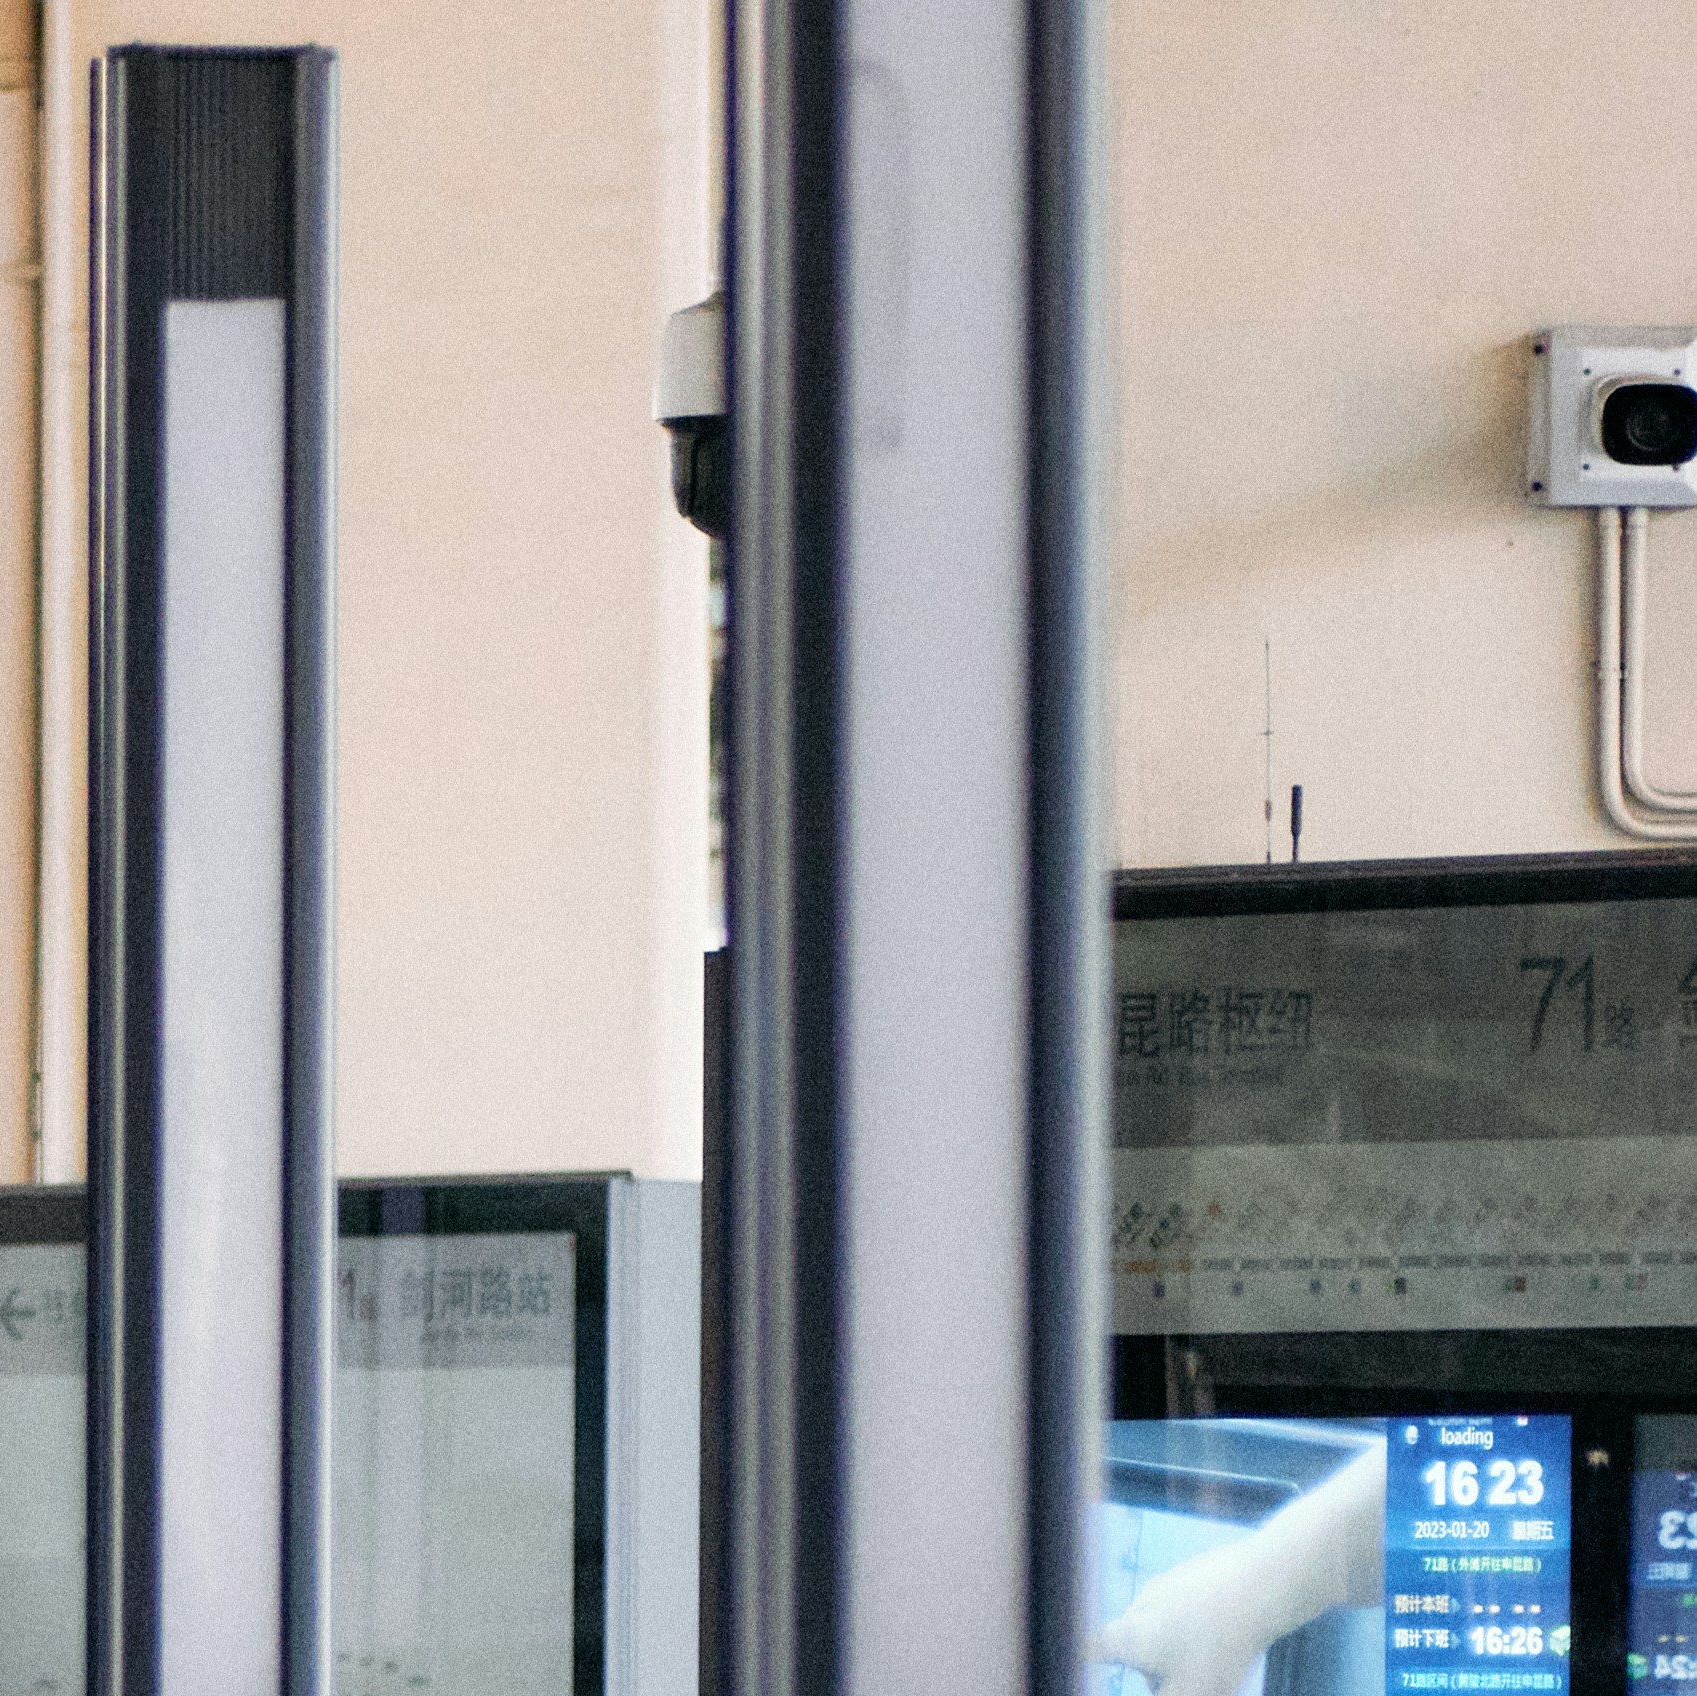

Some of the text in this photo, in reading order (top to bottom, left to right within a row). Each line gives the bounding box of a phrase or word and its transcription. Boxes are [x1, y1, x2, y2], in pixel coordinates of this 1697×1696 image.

[1518, 952, 1635, 1052] 71路
[1440, 1427, 1494, 1451] loading
[1423, 1459, 1545, 1507] 16 23
[1414, 1519, 1555, 1541] 2023-01-20 星期五
[1470, 1625, 1544, 1656] 16:26
